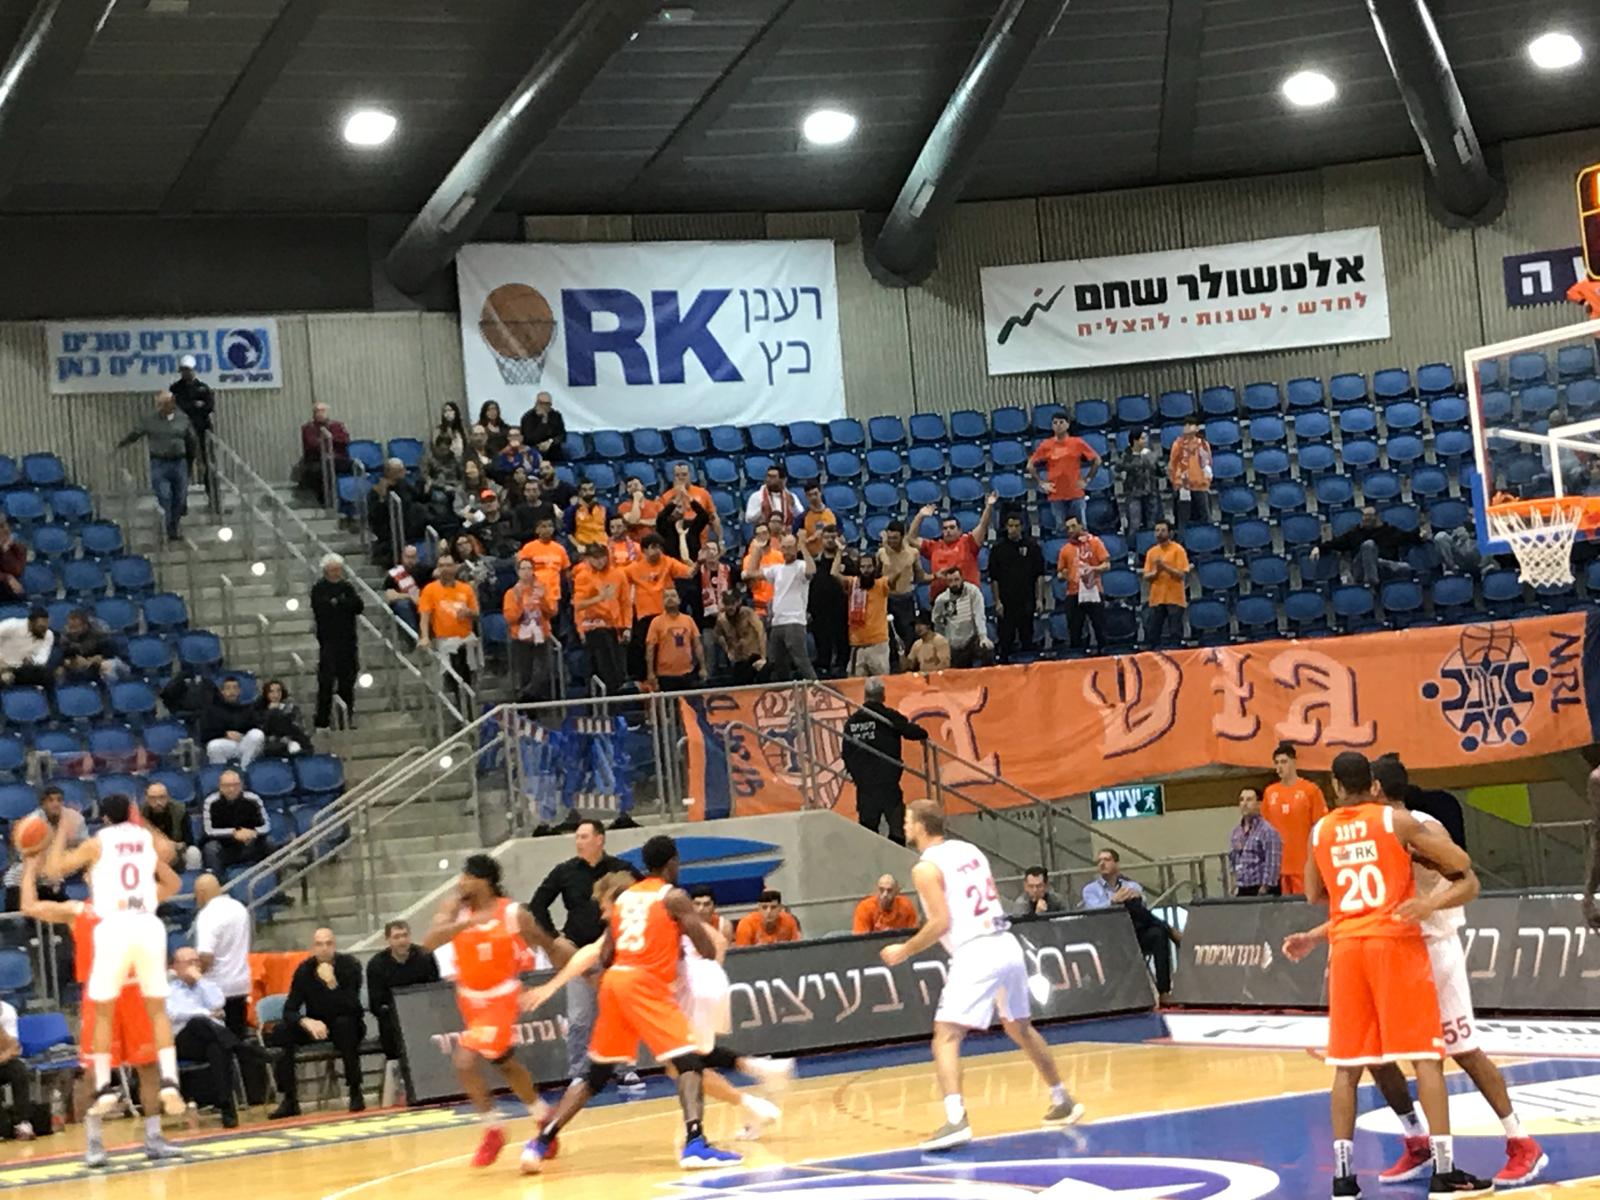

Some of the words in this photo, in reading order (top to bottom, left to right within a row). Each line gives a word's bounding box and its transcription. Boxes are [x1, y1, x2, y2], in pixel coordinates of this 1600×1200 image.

[1177, 251, 1365, 301] אלטשולר
[1074, 276, 1168, 312] שחם
[1297, 291, 1368, 315] לחדש
[739, 286, 823, 333] רענן
[1196, 303, 1271, 327] לשנות
[560, 288, 744, 388] RK
[1077, 312, 1171, 338] להצליח
[140, 330, 209, 350] דברים
[57, 356, 101, 382] כאן
[110, 350, 212, 376] מחילים
[759, 340, 812, 386] כץ
[1549, 630, 1582, 714] MRL
[1095, 788, 1142, 820] יציאה
[1335, 820, 1368, 843] לונג
[1355, 845, 1376, 859] RK
[121, 863, 140, 891] 0
[1336, 864, 1386, 912] 20
[727, 963, 906, 1030] בעיצומ
[1443, 1016, 1472, 1045] 55
